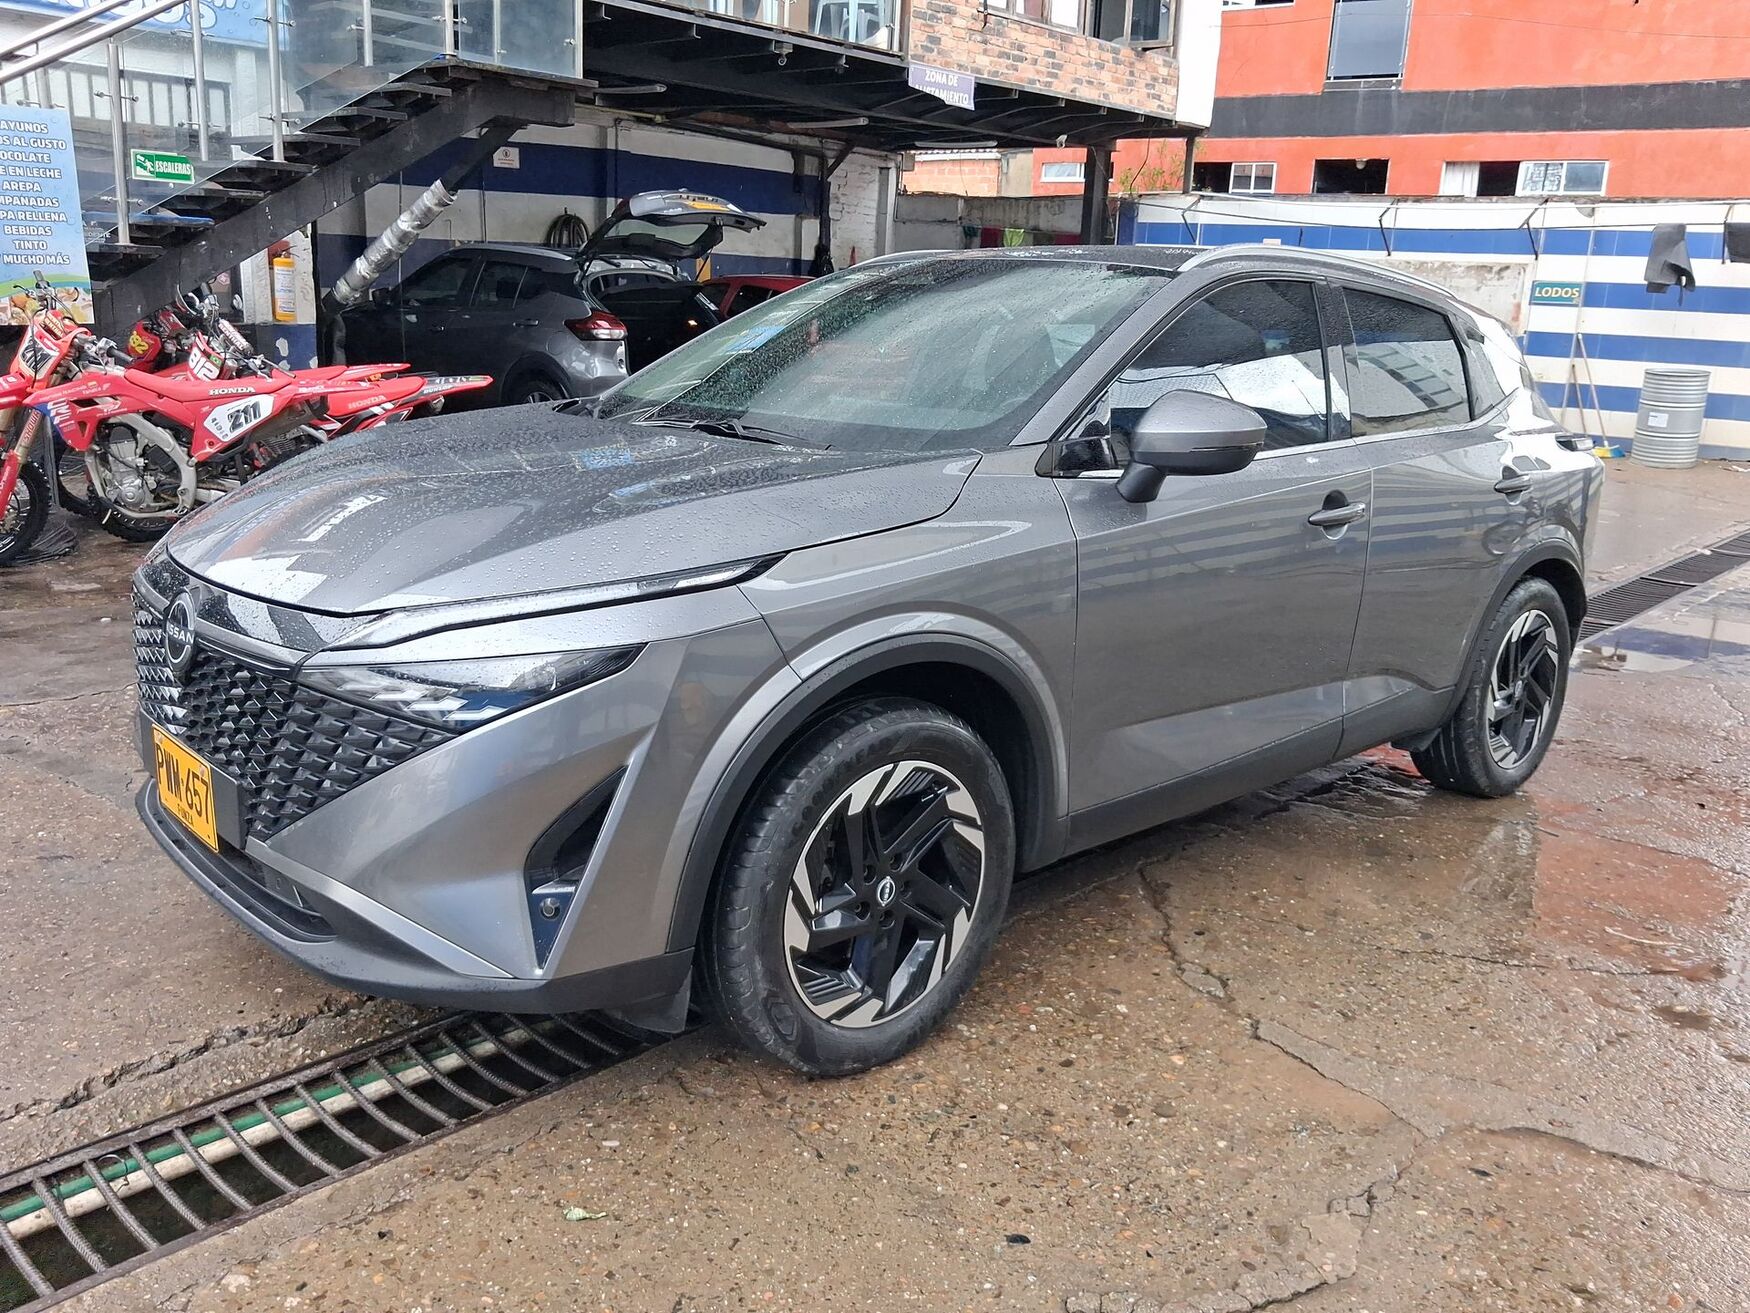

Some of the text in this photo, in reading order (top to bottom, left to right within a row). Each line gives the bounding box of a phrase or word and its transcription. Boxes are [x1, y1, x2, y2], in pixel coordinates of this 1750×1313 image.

[925, 71, 959, 87] ZONA DE
[0, 120, 48, 133] AYUNOS
[13, 136, 28, 147] AL
[29, 138, 67, 150] GUSTO
[0, 150, 51, 163] OCOLATE
[8, 166, 24, 176] EN
[26, 167, 62, 179] LECHE
[155, 161, 191, 175] ESCALERAS
[3, 181, 42, 192] AREPA
[17, 211, 68, 222] RELLENA
[4, 225, 52, 236] BEBIDAS
[13, 240, 47, 250] TINTO
[3, 252, 70, 265] MUCHO MÁS
[1535, 287, 1580, 298] LODOS
[209, 386, 256, 396] HONDA
[347, 395, 386, 409] HONDA
